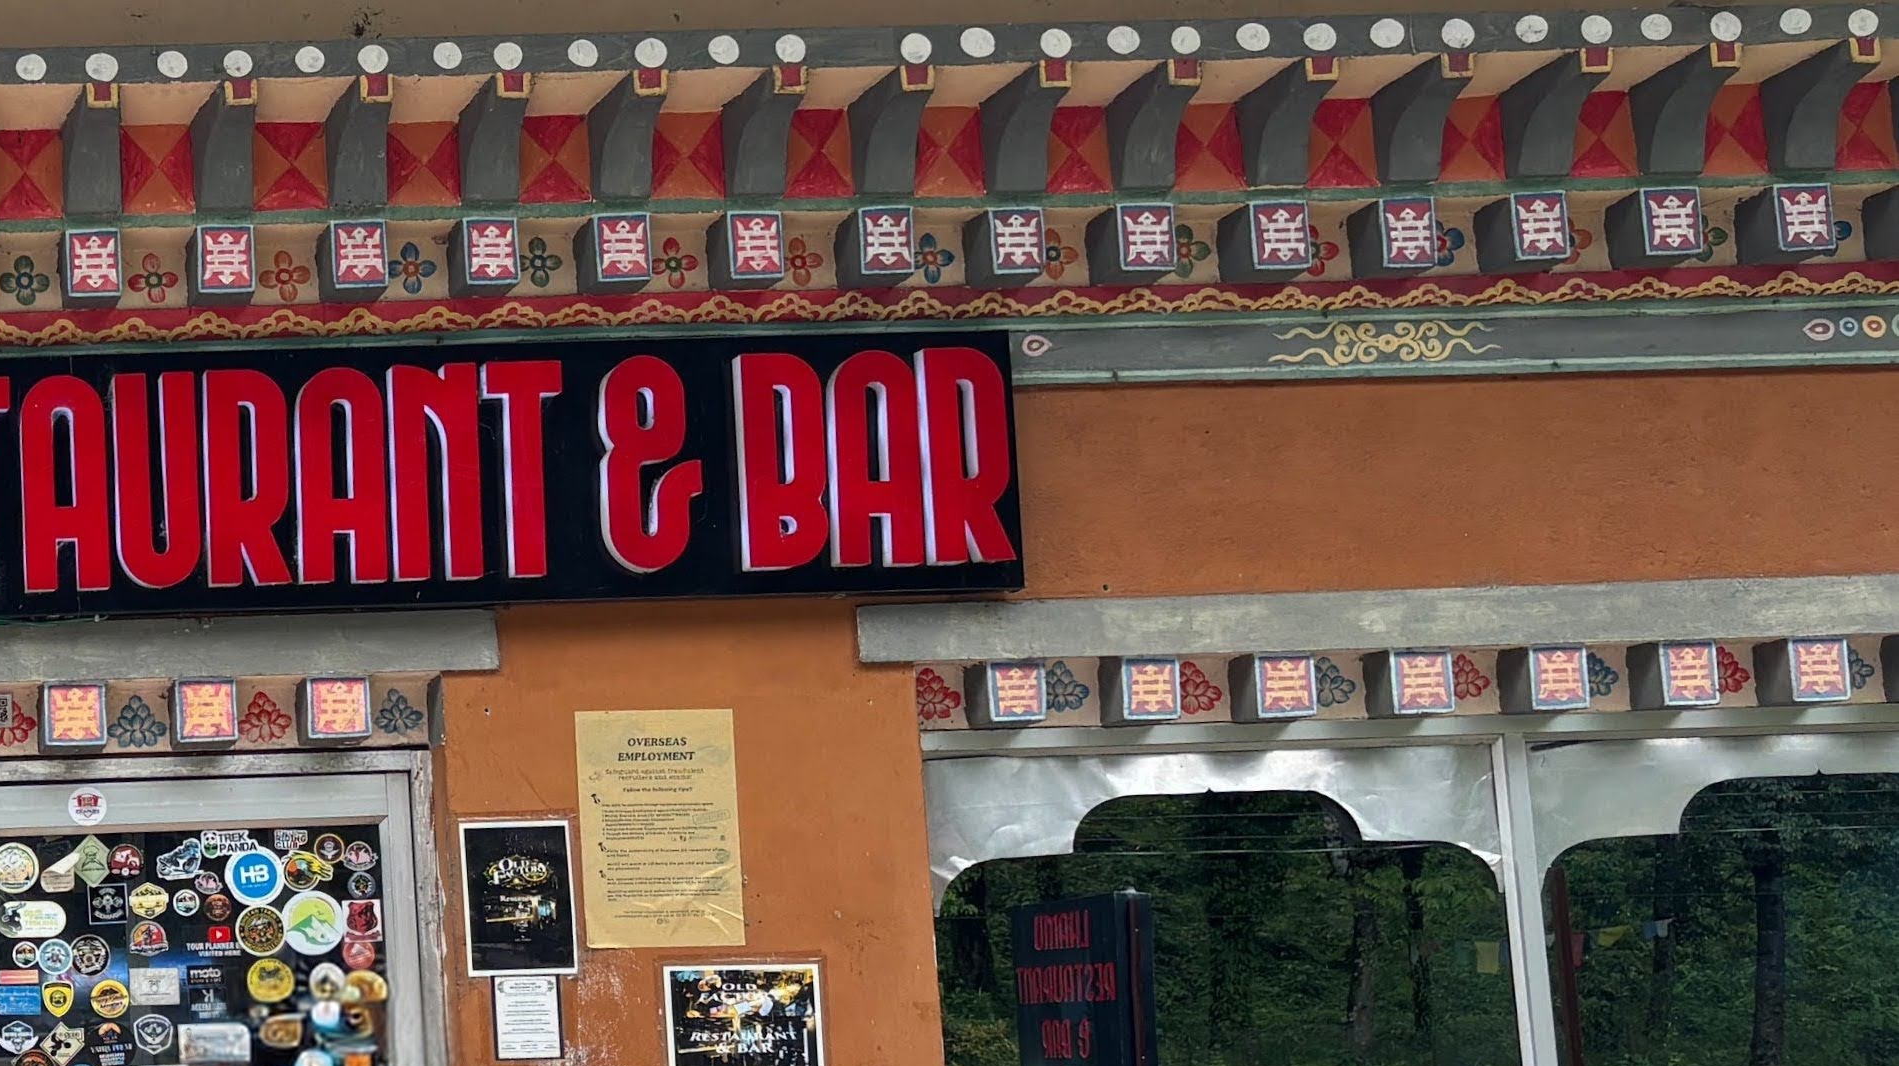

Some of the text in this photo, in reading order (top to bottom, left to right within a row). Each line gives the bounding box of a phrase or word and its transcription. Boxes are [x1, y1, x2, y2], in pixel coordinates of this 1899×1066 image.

[597, 353, 704, 574] &
[731, 345, 1017, 573] BAR
[627, 737, 688, 747] OVERSEAS
[617, 751, 696, 762] EMPLOYMENT
[219, 832, 248, 844] TREK
[219, 841, 258, 853] PANDA
[722, 982, 758, 992] OLD
[695, 990, 776, 1005] FACTO
[689, 1030, 797, 1042] RESTAURANT
[737, 1042, 775, 1054] BAR
